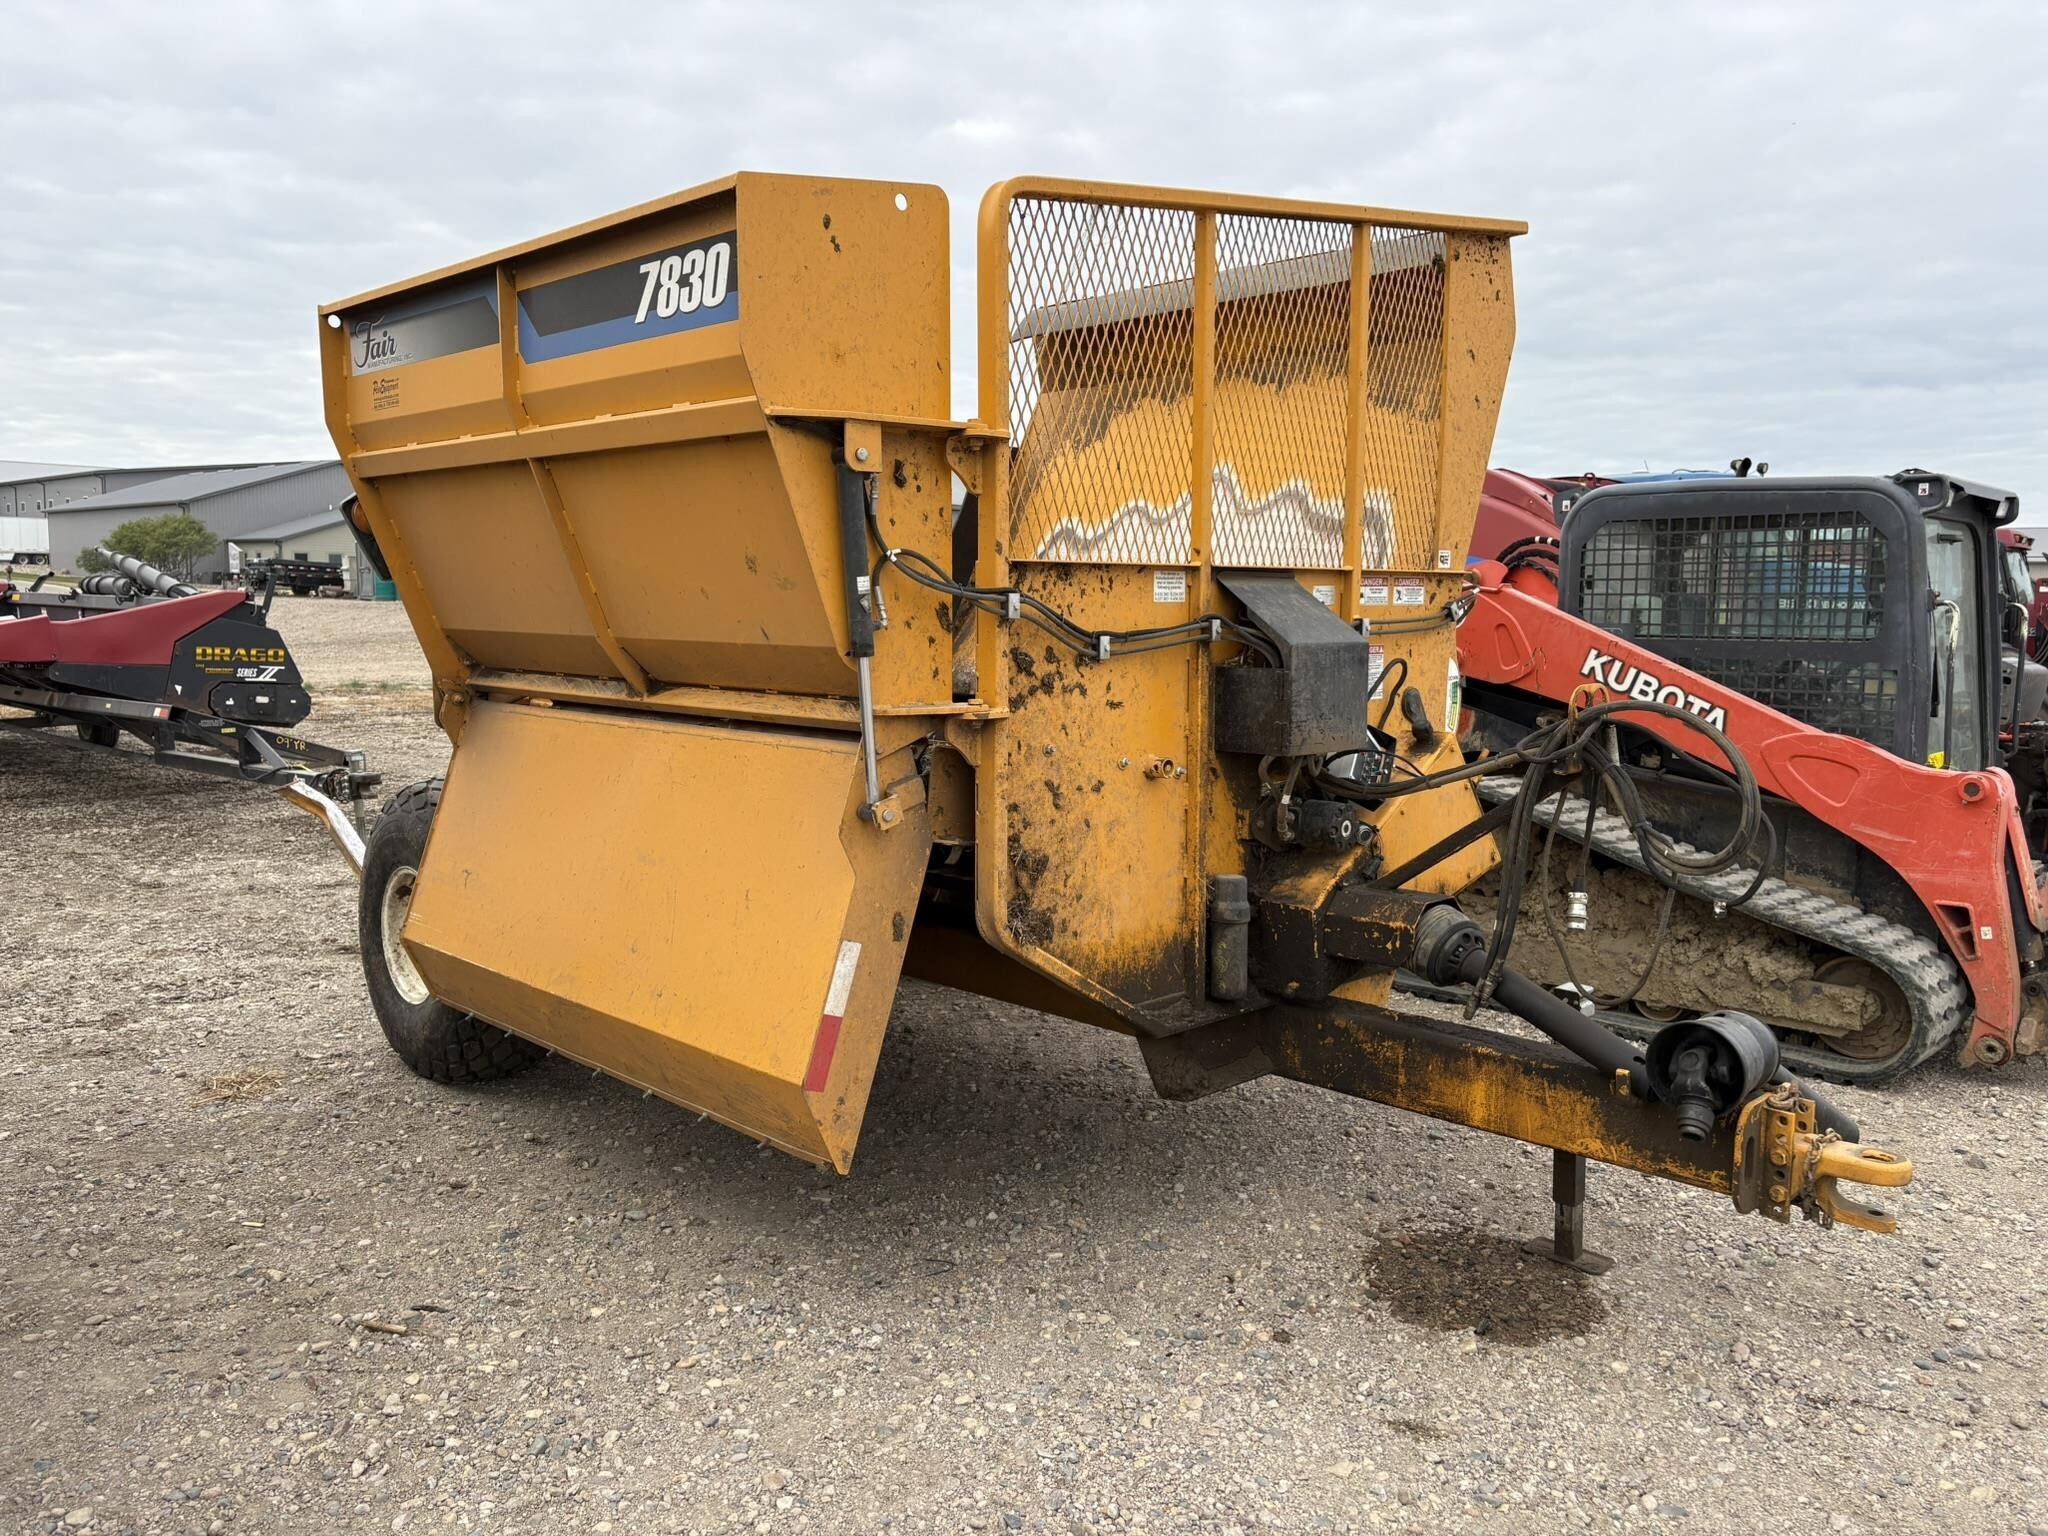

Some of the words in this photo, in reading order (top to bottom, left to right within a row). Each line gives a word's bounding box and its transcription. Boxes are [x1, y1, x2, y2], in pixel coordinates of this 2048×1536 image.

[635, 242, 731, 324] 7830
[354, 314, 397, 368] Fair
[1399, 578, 1420, 586] DANGER
[195, 646, 285, 663] DRAGO
[236, 667, 258, 678] SERIES
[1580, 648, 1727, 733] KUBOTA
